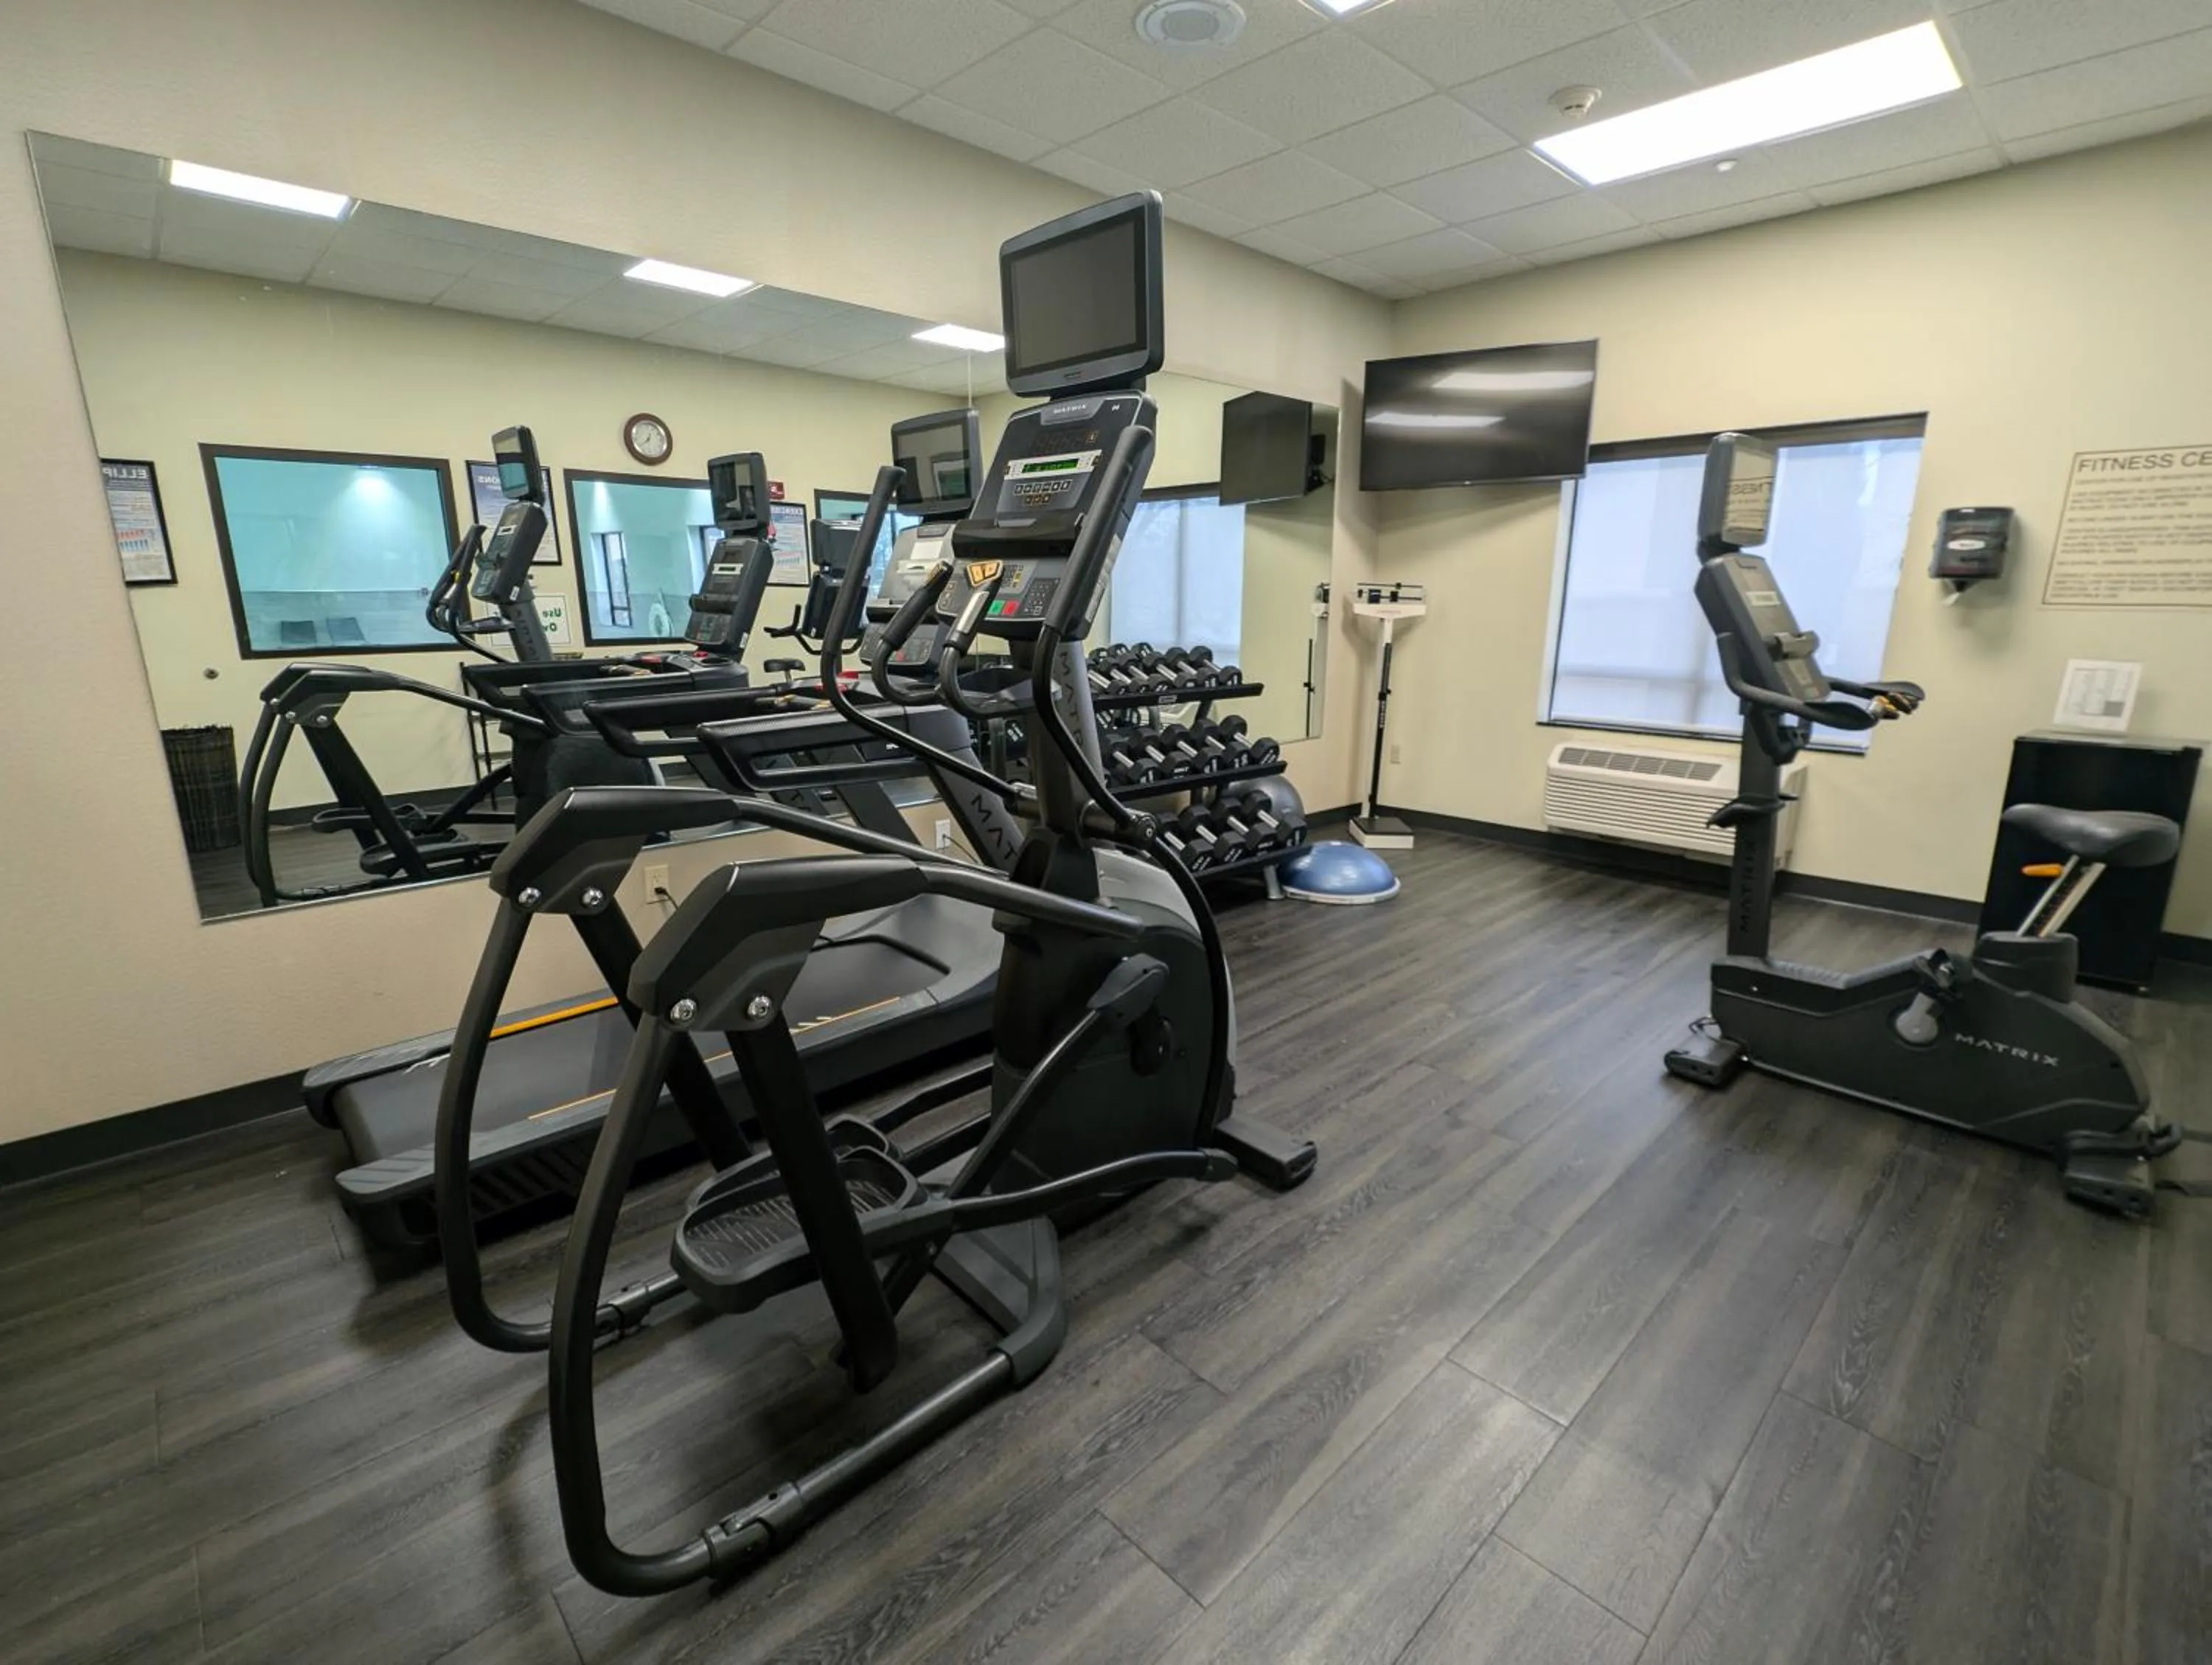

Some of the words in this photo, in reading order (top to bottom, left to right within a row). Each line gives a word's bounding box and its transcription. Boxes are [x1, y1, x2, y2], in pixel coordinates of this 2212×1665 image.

[2076, 452, 2174, 473] FITNESS
[2180, 451, 2212, 467] CE
[1955, 1033, 2059, 1067] MATRIX
